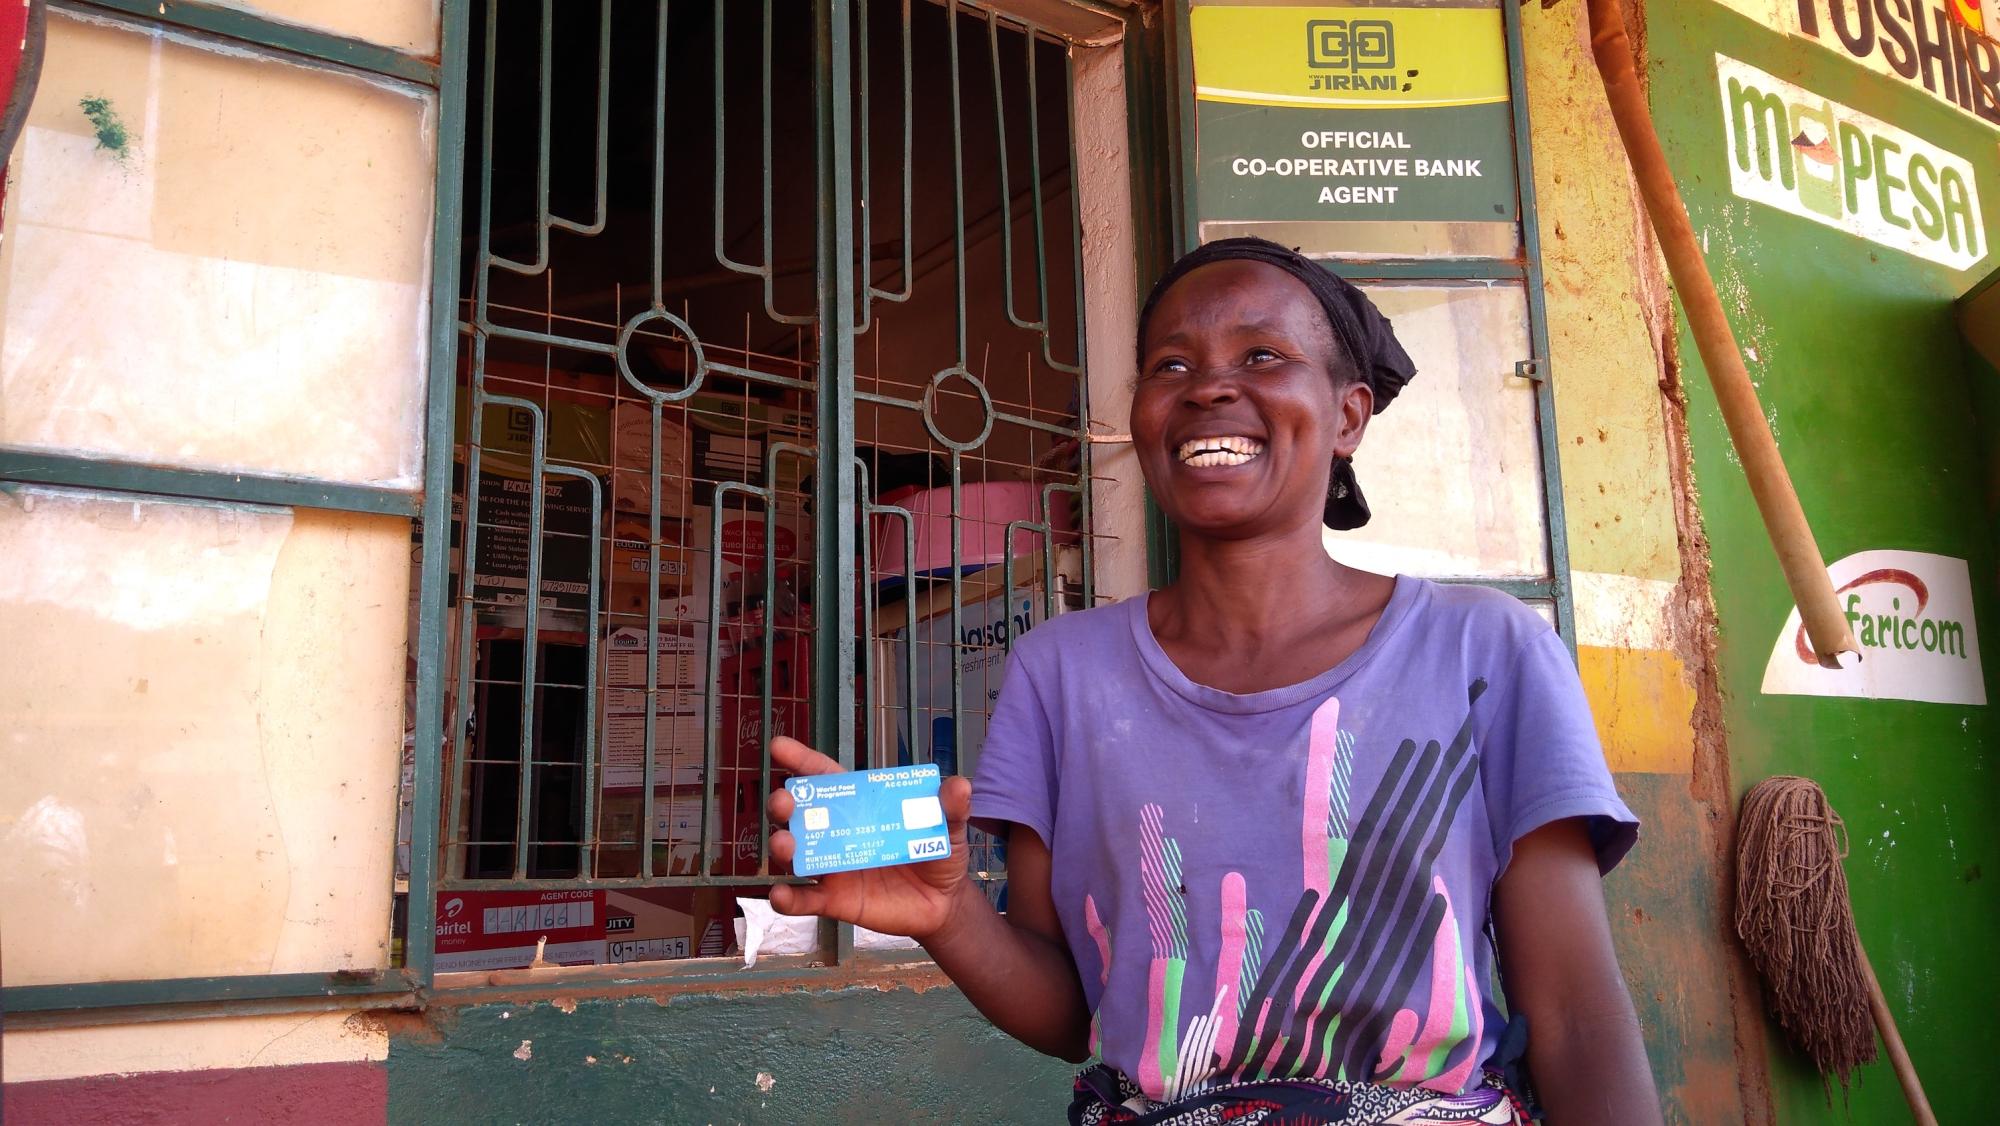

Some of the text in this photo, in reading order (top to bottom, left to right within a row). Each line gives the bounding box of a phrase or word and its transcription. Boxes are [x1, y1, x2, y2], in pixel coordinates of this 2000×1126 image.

[1309, 75, 1397, 90] JIRANI
[1301, 132, 1411, 149] OFFICIAL
[1232, 159, 1482, 177] CO-OPERATIVE BANK
[1318, 187, 1398, 204] AGENT
[1845, 594, 1967, 659] faricom
[885, 779, 922, 788] Account
[817, 790, 856, 799] Programme
[913, 841, 945, 855] VISA
[541, 890, 594, 901] AGENT CODE
[436, 921, 472, 935] airtel
[606, 918, 632, 929] UITY
[441, 938, 466, 946] money
[459, 958, 485, 968] MONEY
